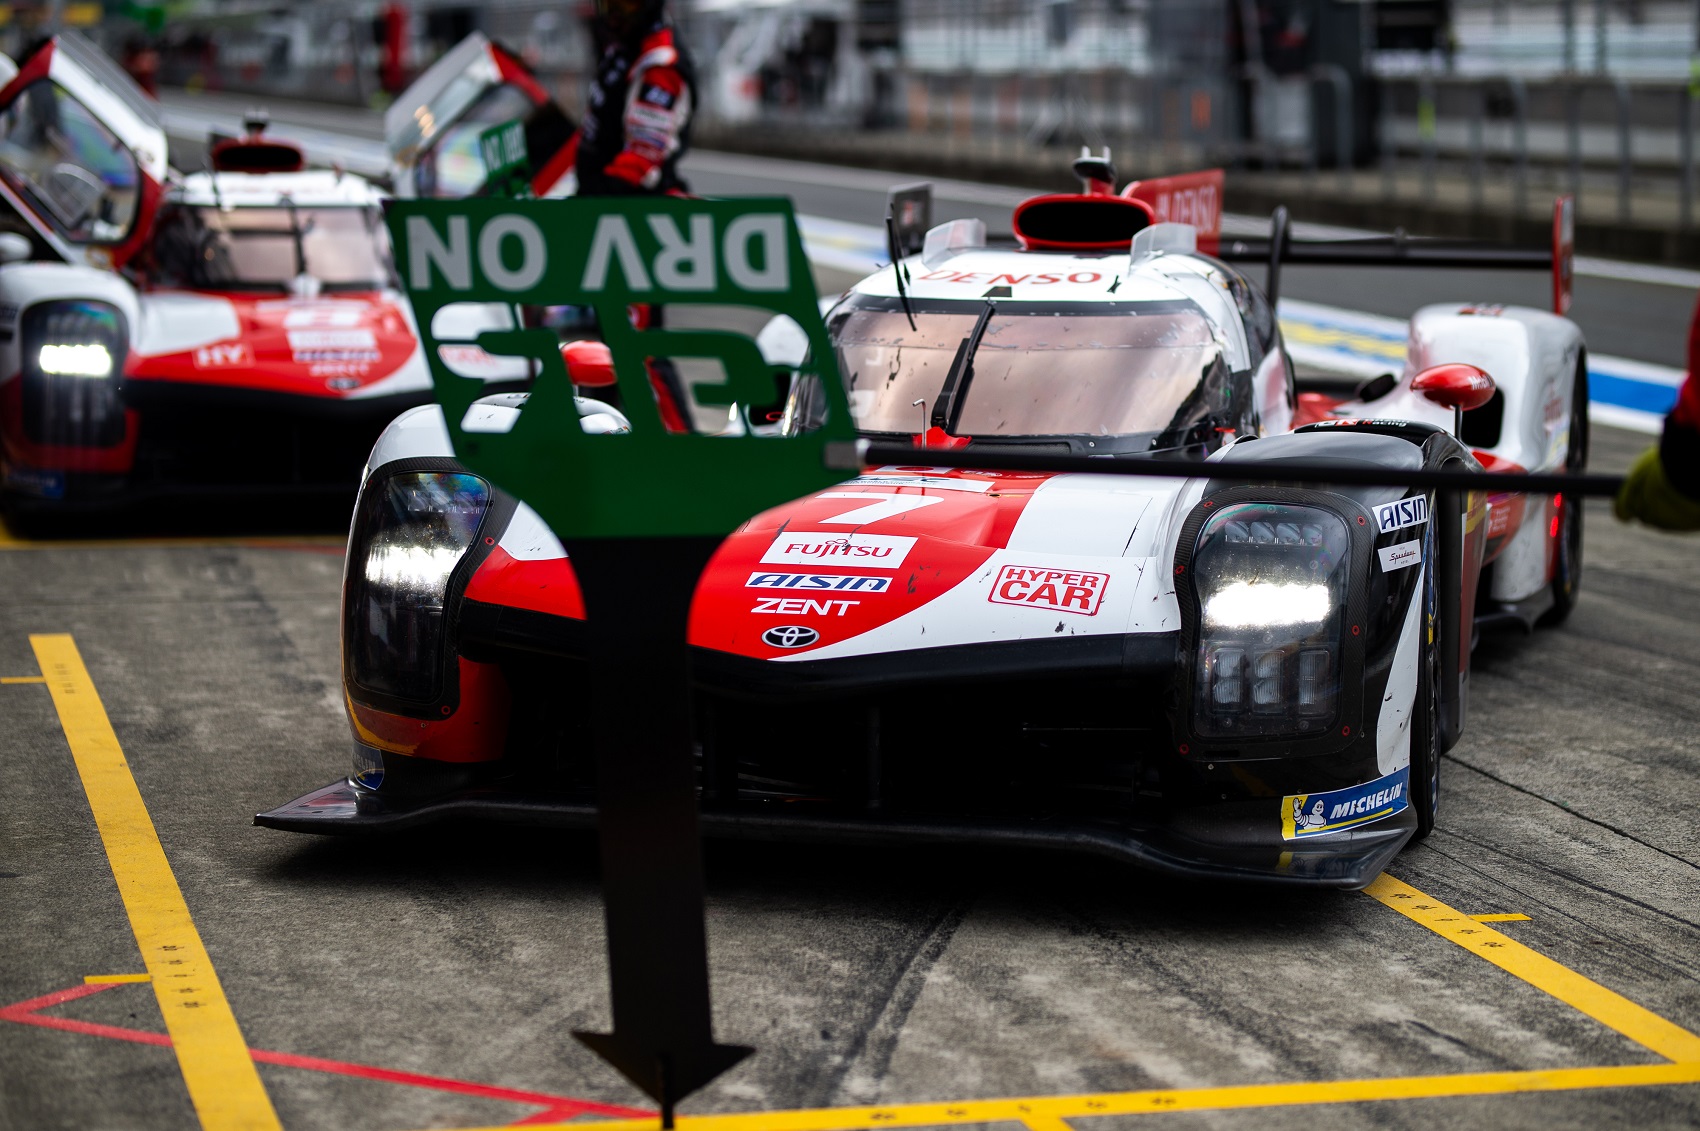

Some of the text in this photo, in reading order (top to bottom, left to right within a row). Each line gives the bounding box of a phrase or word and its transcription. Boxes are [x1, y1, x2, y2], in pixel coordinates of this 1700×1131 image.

[406, 213, 790, 291] DRV ON
[917, 270, 1102, 284] DENSO
[815, 491, 945, 525] 7
[1380, 498, 1426, 530] AISIN
[784, 543, 893, 558] FUJITSU
[749, 575, 888, 591] AISIN
[1006, 568, 1099, 588] HYPER
[751, 597, 860, 616] ZENT
[1000, 580, 1094, 610] CAR
[1330, 782, 1403, 820] MICHELIN
